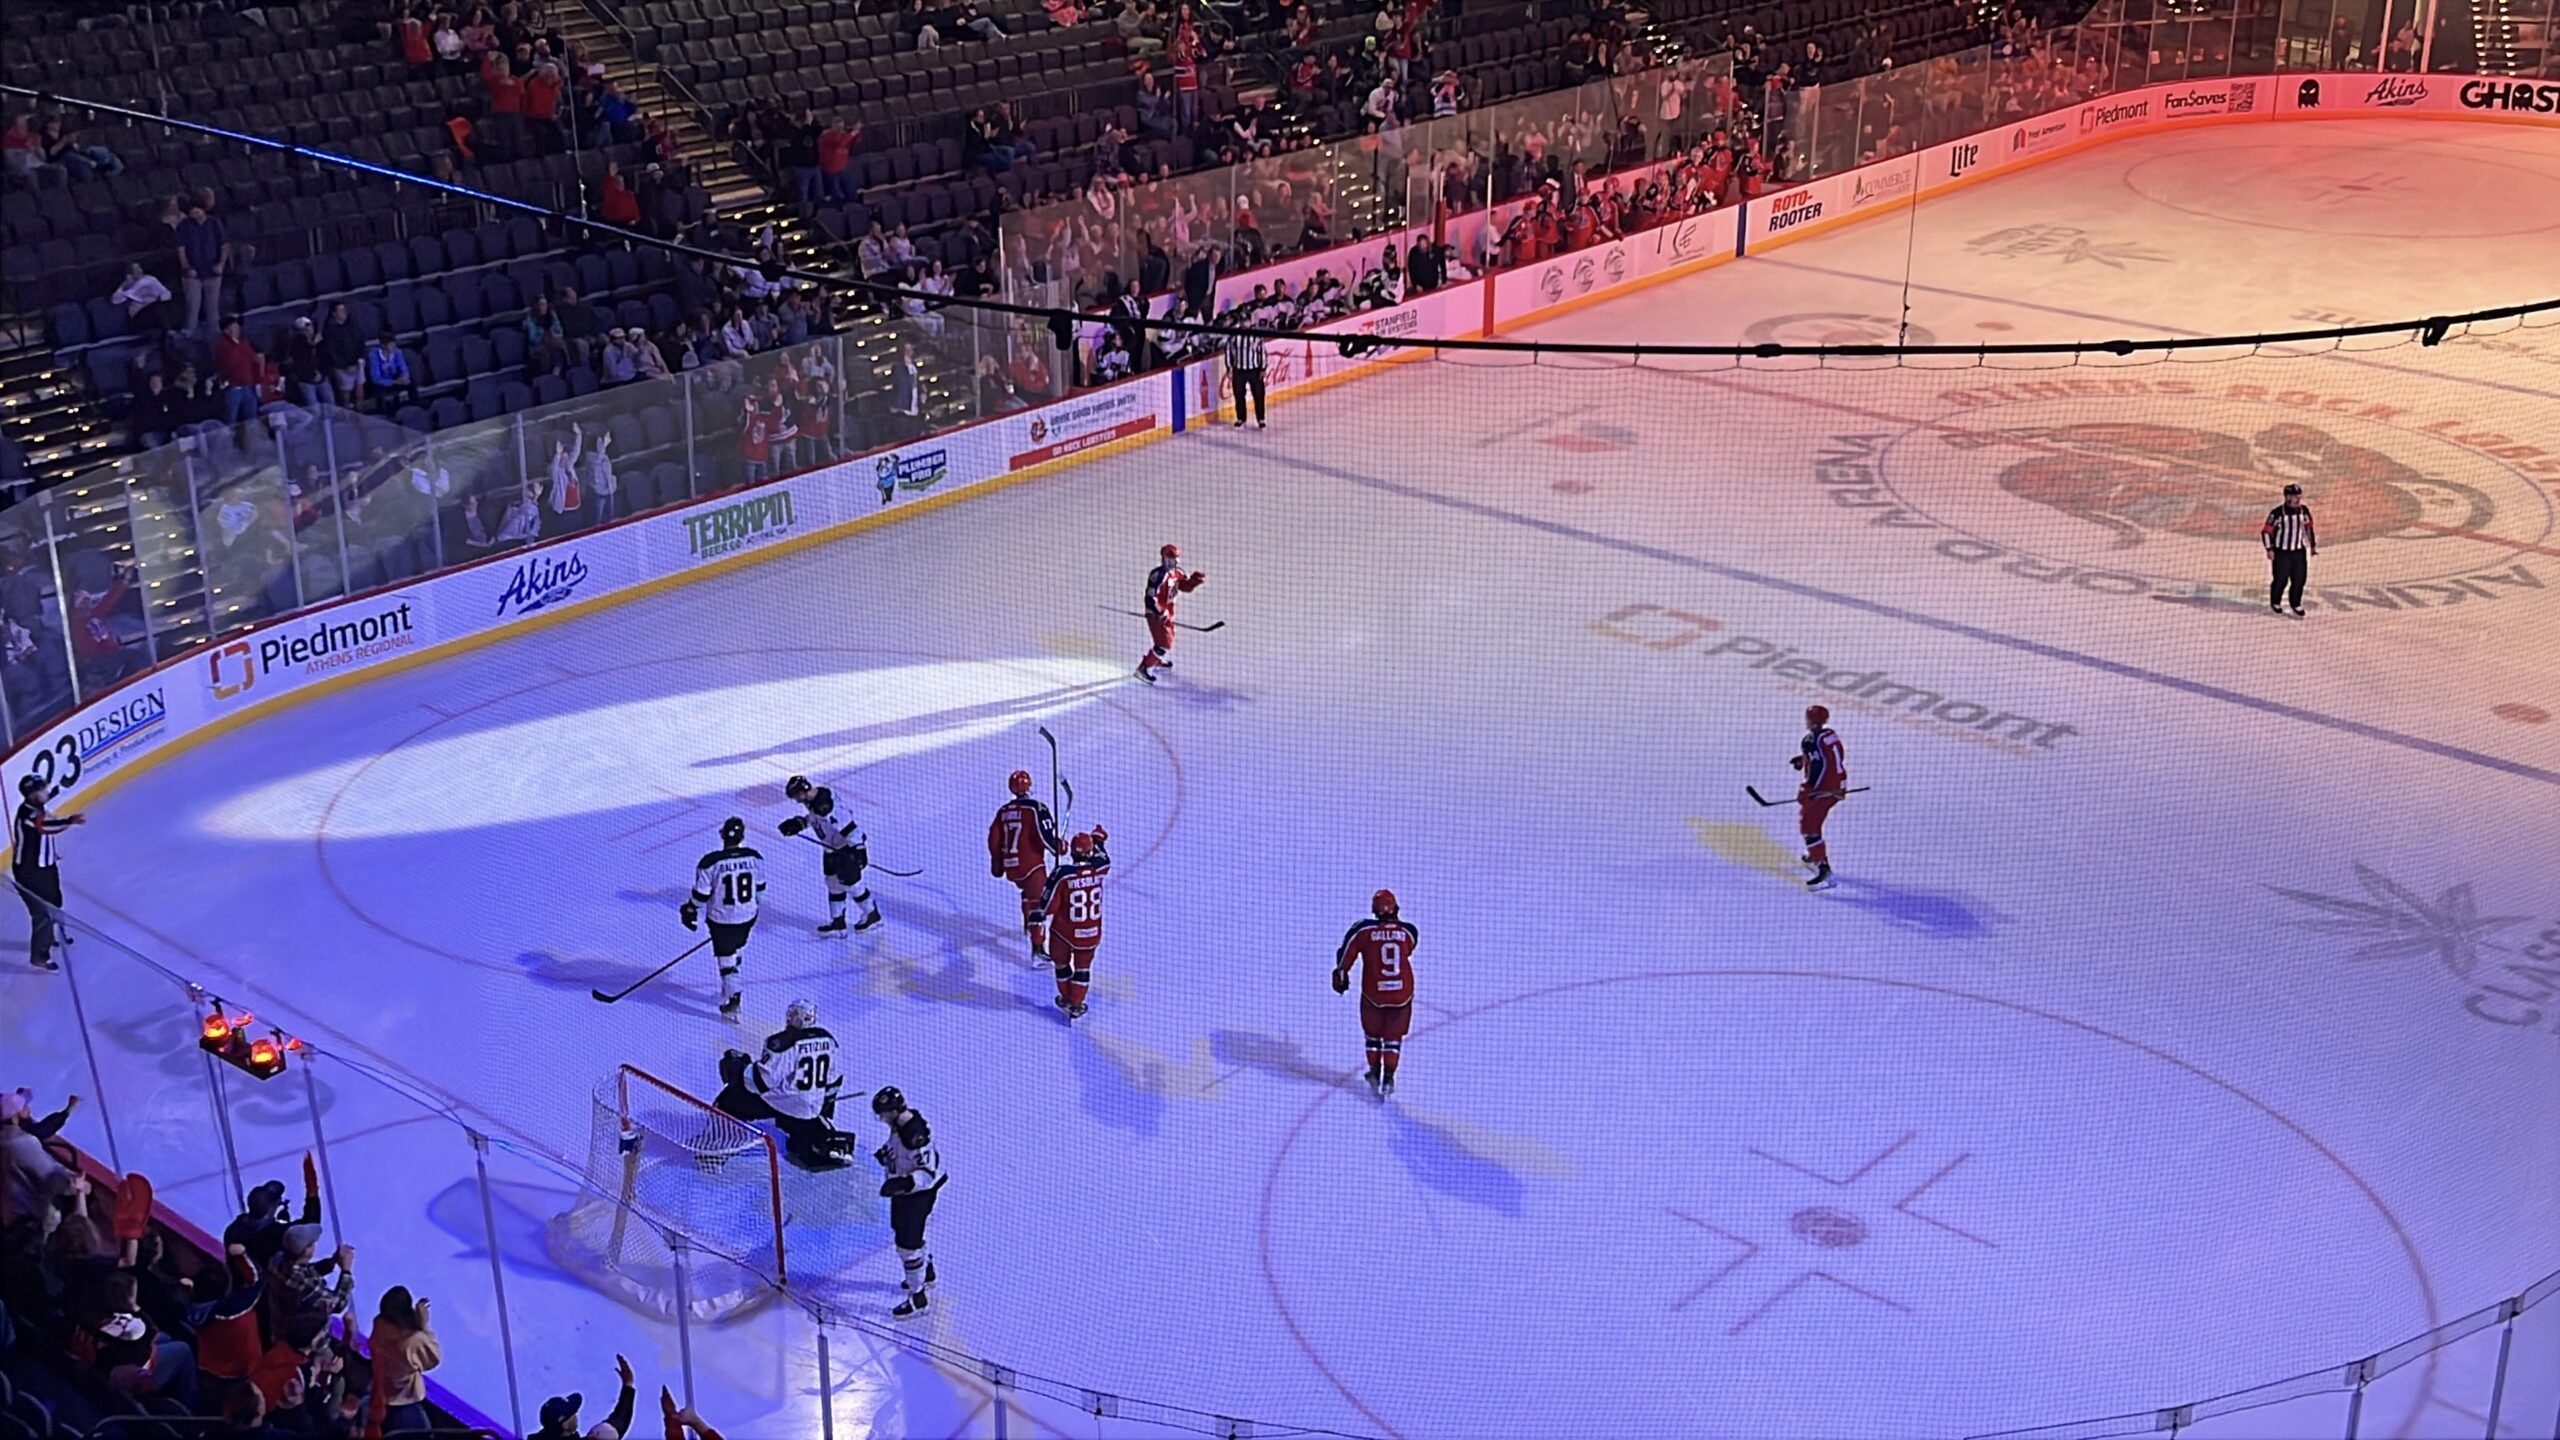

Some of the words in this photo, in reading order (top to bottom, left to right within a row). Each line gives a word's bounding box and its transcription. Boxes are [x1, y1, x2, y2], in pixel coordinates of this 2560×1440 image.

[2364, 77, 2429, 105] Akins
[2095, 101, 2149, 127] Piedmont
[1949, 144, 1979, 178] Lite
[1768, 201, 1823, 232] ROOTER
[1771, 189, 1814, 214] ROTO-
[1375, 308, 1418, 330] STANFIELD
[682, 490, 795, 556] TERRAPIN
[497, 550, 588, 616] Akins
[260, 602, 413, 675] Piedmont
[305, 650, 354, 676] ATHENS
[355, 634, 415, 661] REGIONAL
[1703, 634, 2081, 750] Piedmont
[78, 687, 166, 753] DESIGN
[1001, 821, 1022, 854] 17
[722, 871, 753, 906] 18
[1069, 886, 1102, 923] 88
[1381, 942, 1401, 977] 9
[796, 1053, 831, 1092] 30
